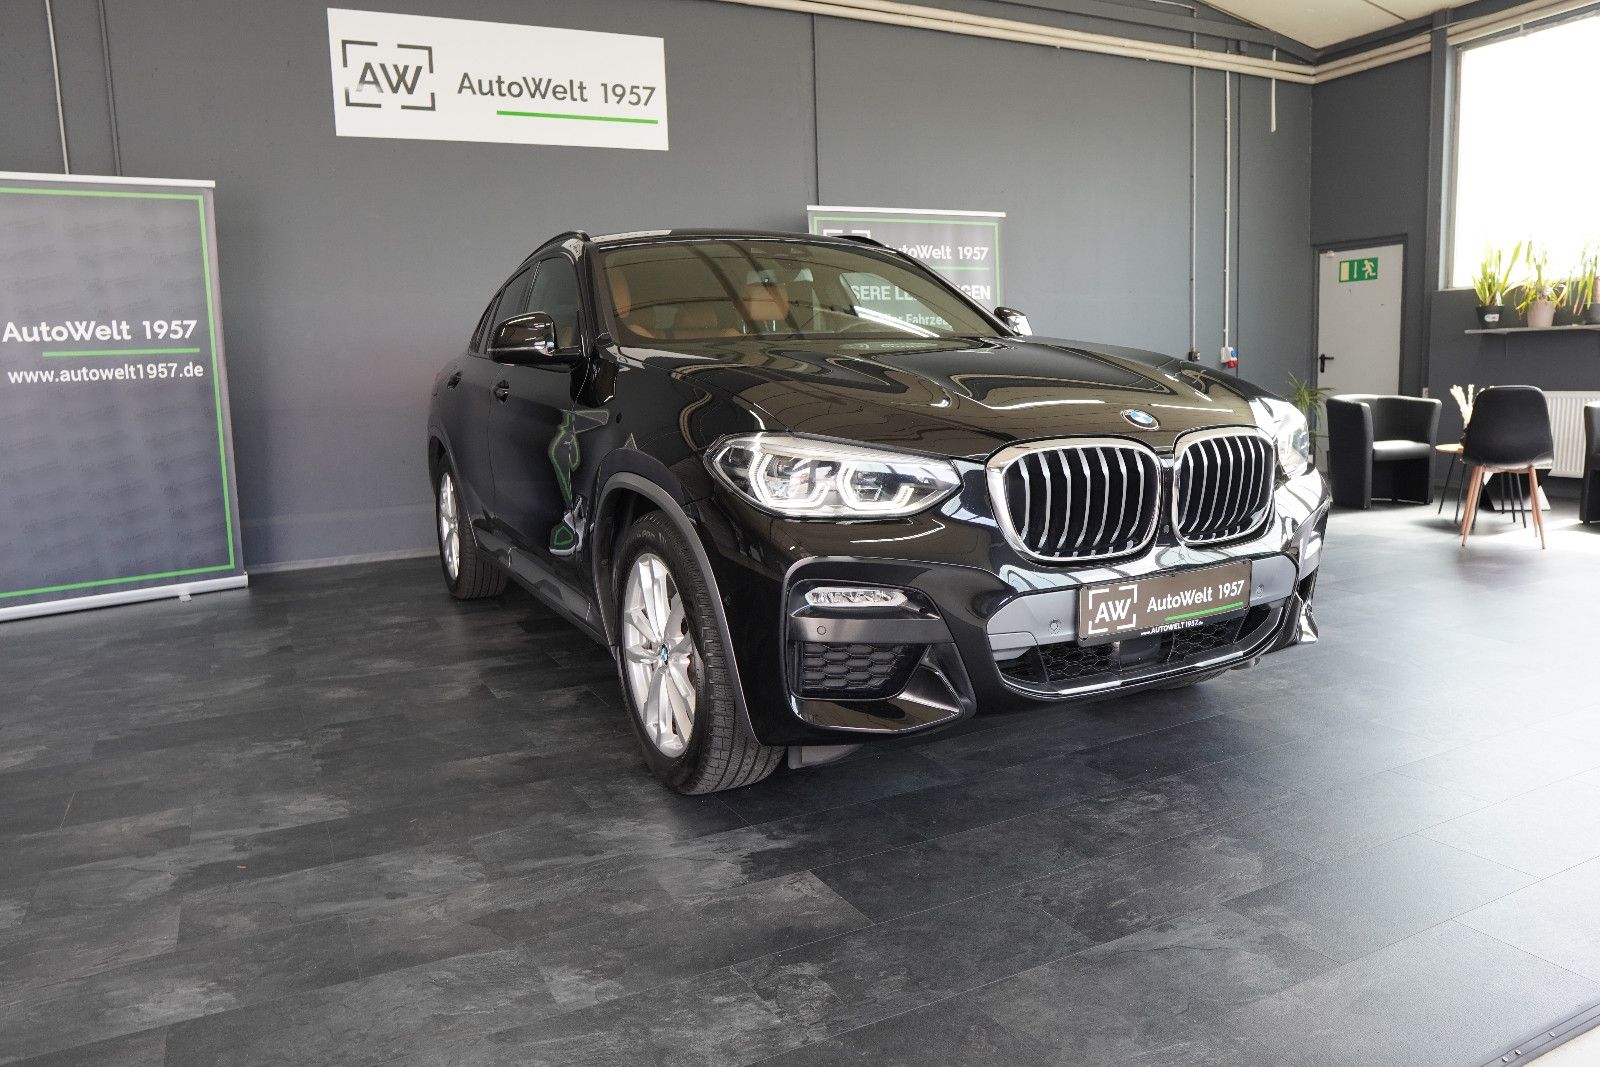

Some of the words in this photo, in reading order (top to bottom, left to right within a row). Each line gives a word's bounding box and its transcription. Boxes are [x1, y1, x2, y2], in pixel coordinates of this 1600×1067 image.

[355, 62, 423, 95] AW
[457, 72, 588, 102] AutoWelt
[600, 82, 656, 107] 1957
[885, 244, 952, 259] toWelt
[957, 246, 989, 260] 1957
[851, 285, 891, 300] SERE
[2, 320, 131, 342] AutoWelt
[142, 319, 198, 340] 1957
[7, 361, 204, 384] www.autowelt1957.de
[1146, 586, 1213, 613] AutoWelt
[1218, 579, 1245, 599] 1957
[1094, 598, 1132, 624] AW
